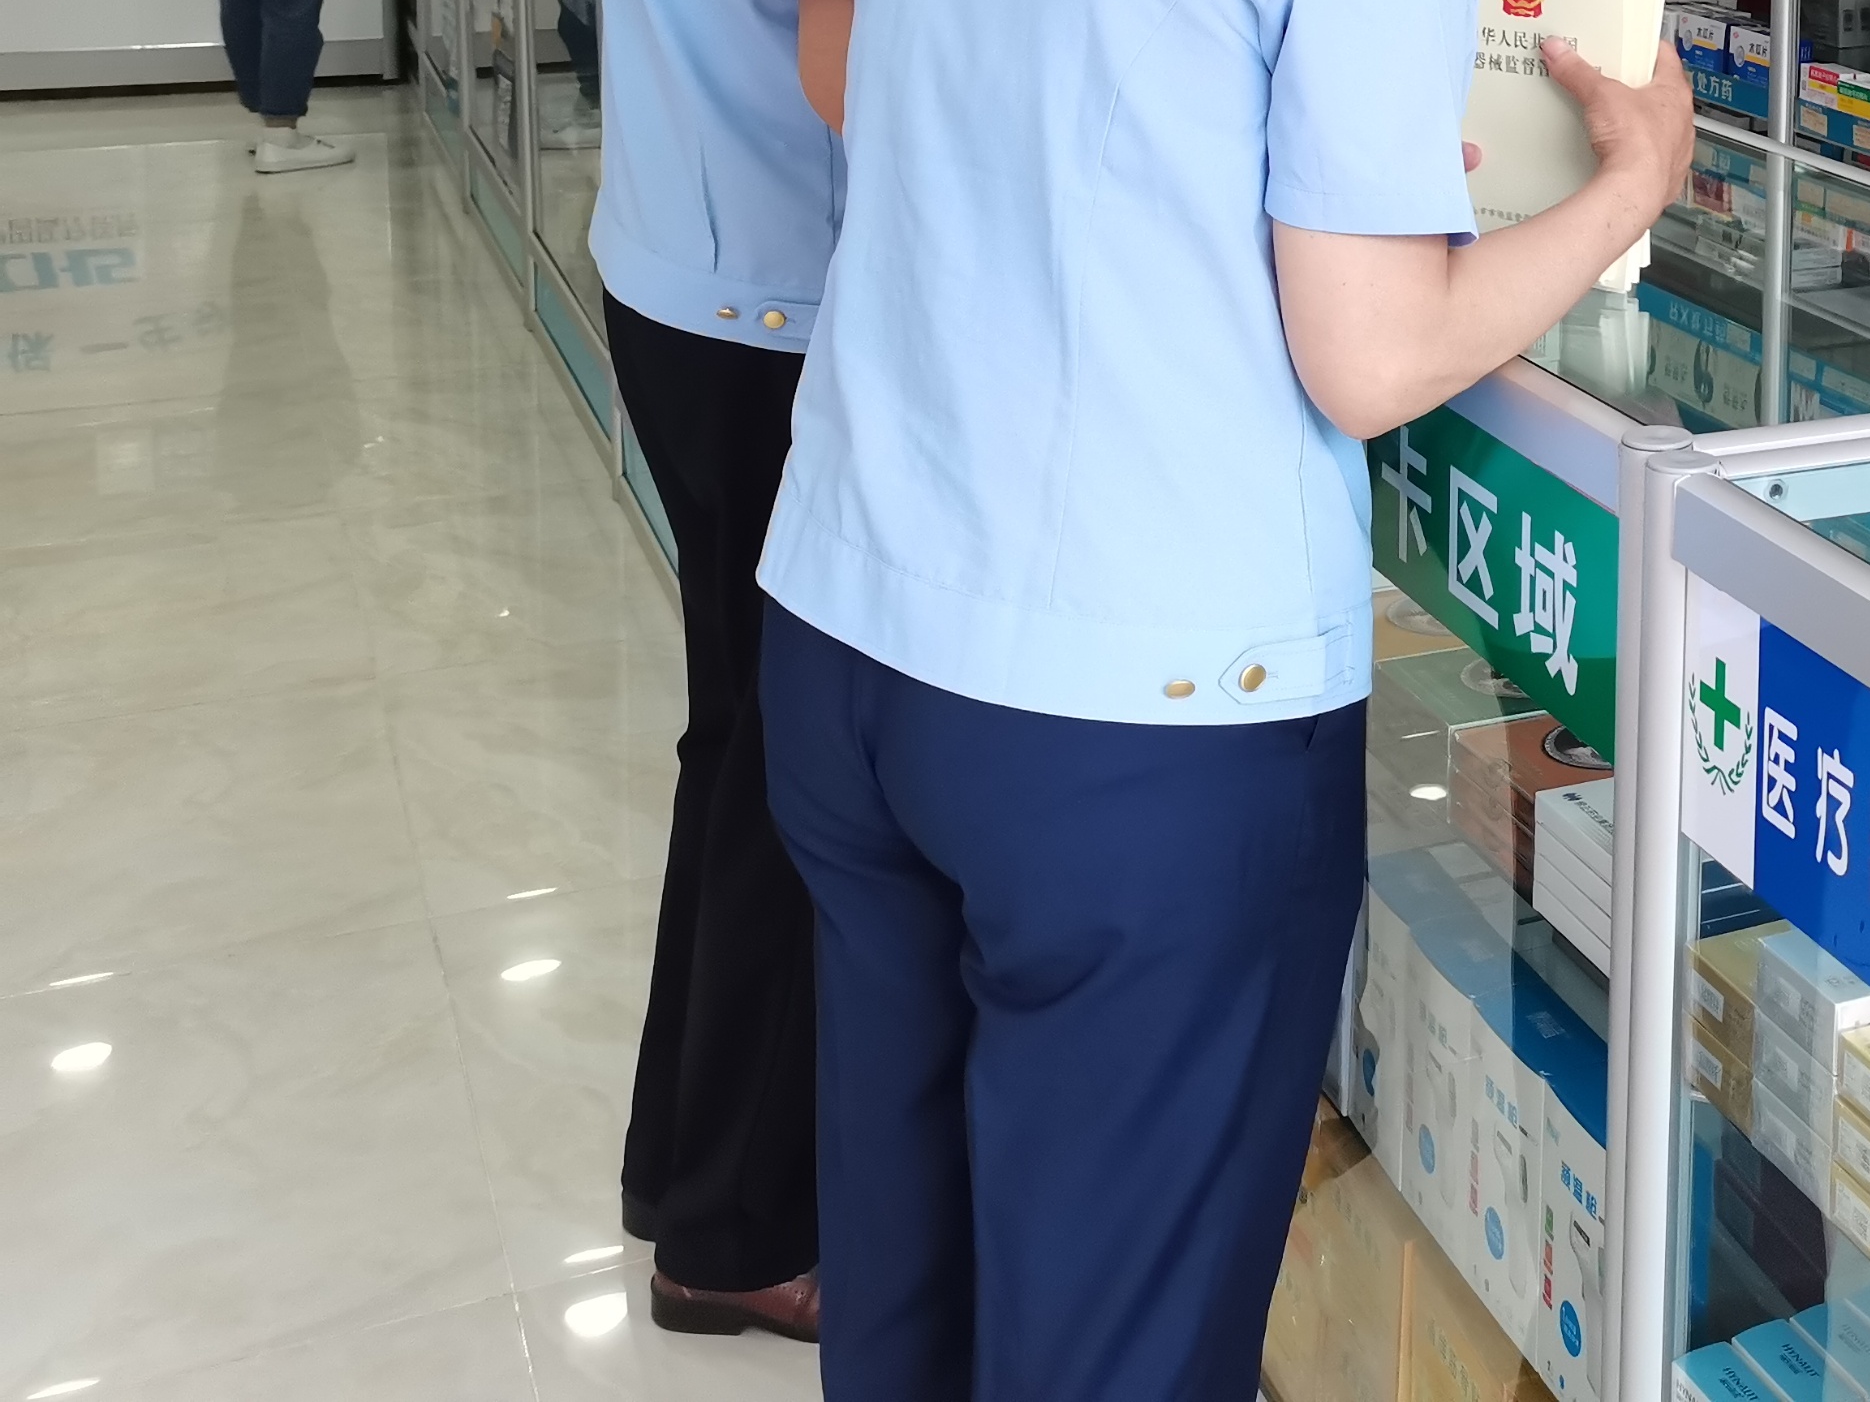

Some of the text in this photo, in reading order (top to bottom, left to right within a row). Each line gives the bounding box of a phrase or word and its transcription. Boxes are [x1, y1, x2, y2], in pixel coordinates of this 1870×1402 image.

[1480, 26, 1578, 53] 华人民共国
[1381, 425, 1579, 696] 卡区域
